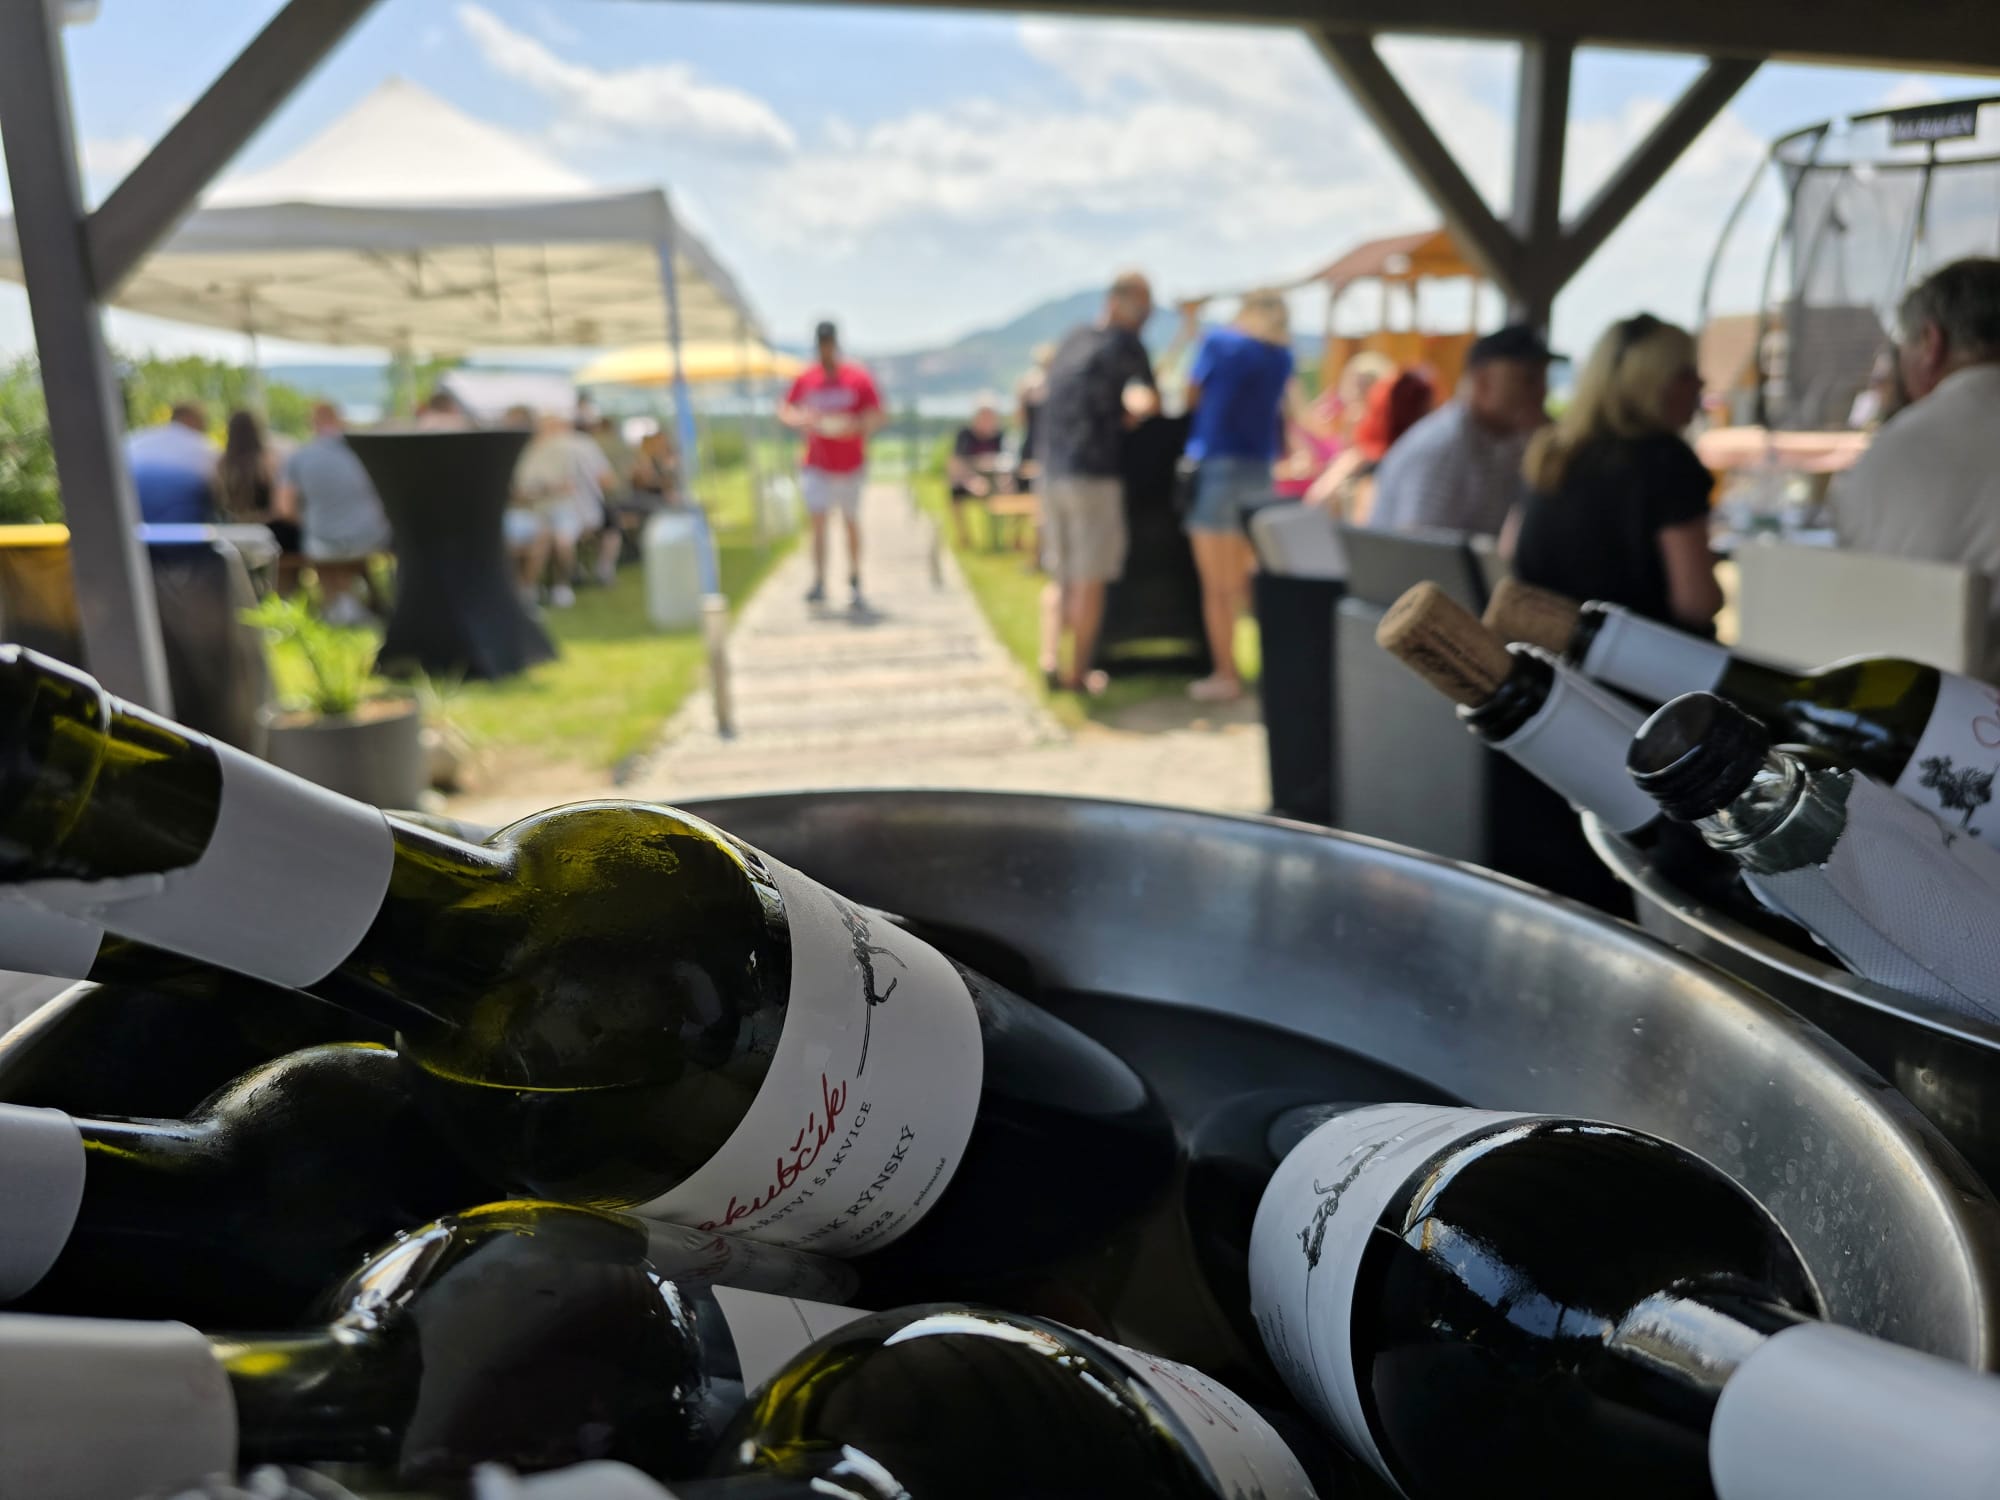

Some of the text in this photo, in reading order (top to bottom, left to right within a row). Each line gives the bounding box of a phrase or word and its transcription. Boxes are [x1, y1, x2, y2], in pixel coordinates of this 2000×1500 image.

[699, 1071, 847, 1232] akubčík
[813, 1101, 872, 1186] ŠAKVICE
[845, 1124, 916, 1217] RÝNSKÝ
[851, 1210, 894, 1241] 2023
